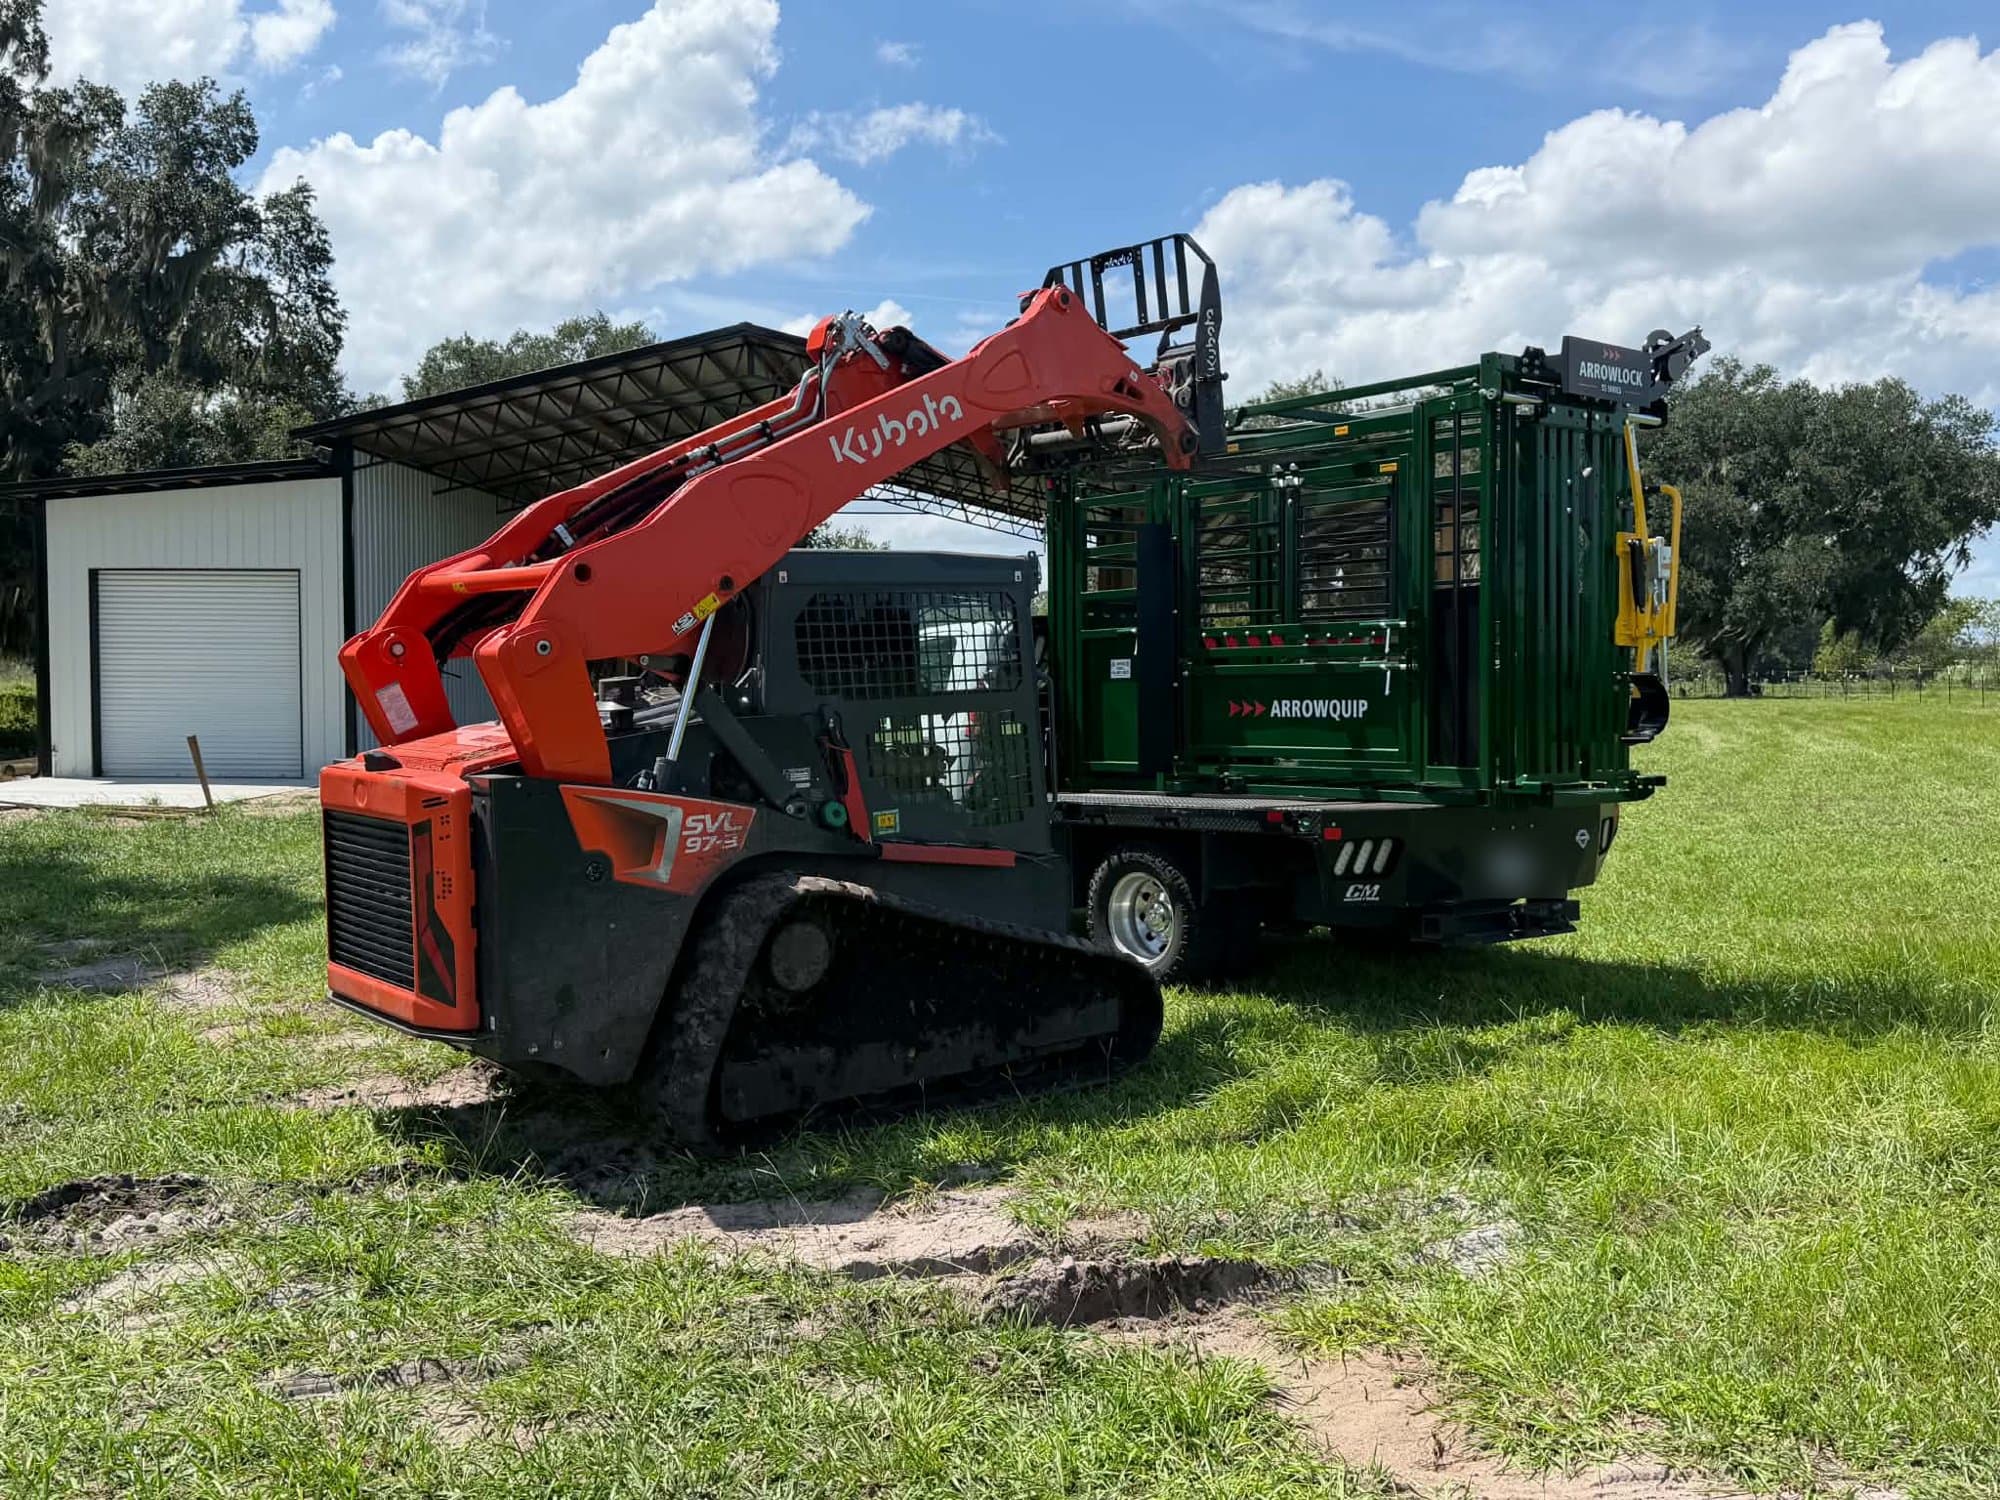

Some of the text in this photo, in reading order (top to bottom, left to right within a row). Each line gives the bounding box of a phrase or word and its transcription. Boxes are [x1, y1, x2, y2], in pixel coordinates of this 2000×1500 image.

[1203, 308, 1217, 372] Kubota
[1579, 361, 1643, 387] ARROWLOCK
[829, 393, 963, 464] Kubota
[1270, 699, 1368, 721] ARROWQUIP
[682, 812, 742, 835] SVL
[1345, 884, 1380, 899] CM
